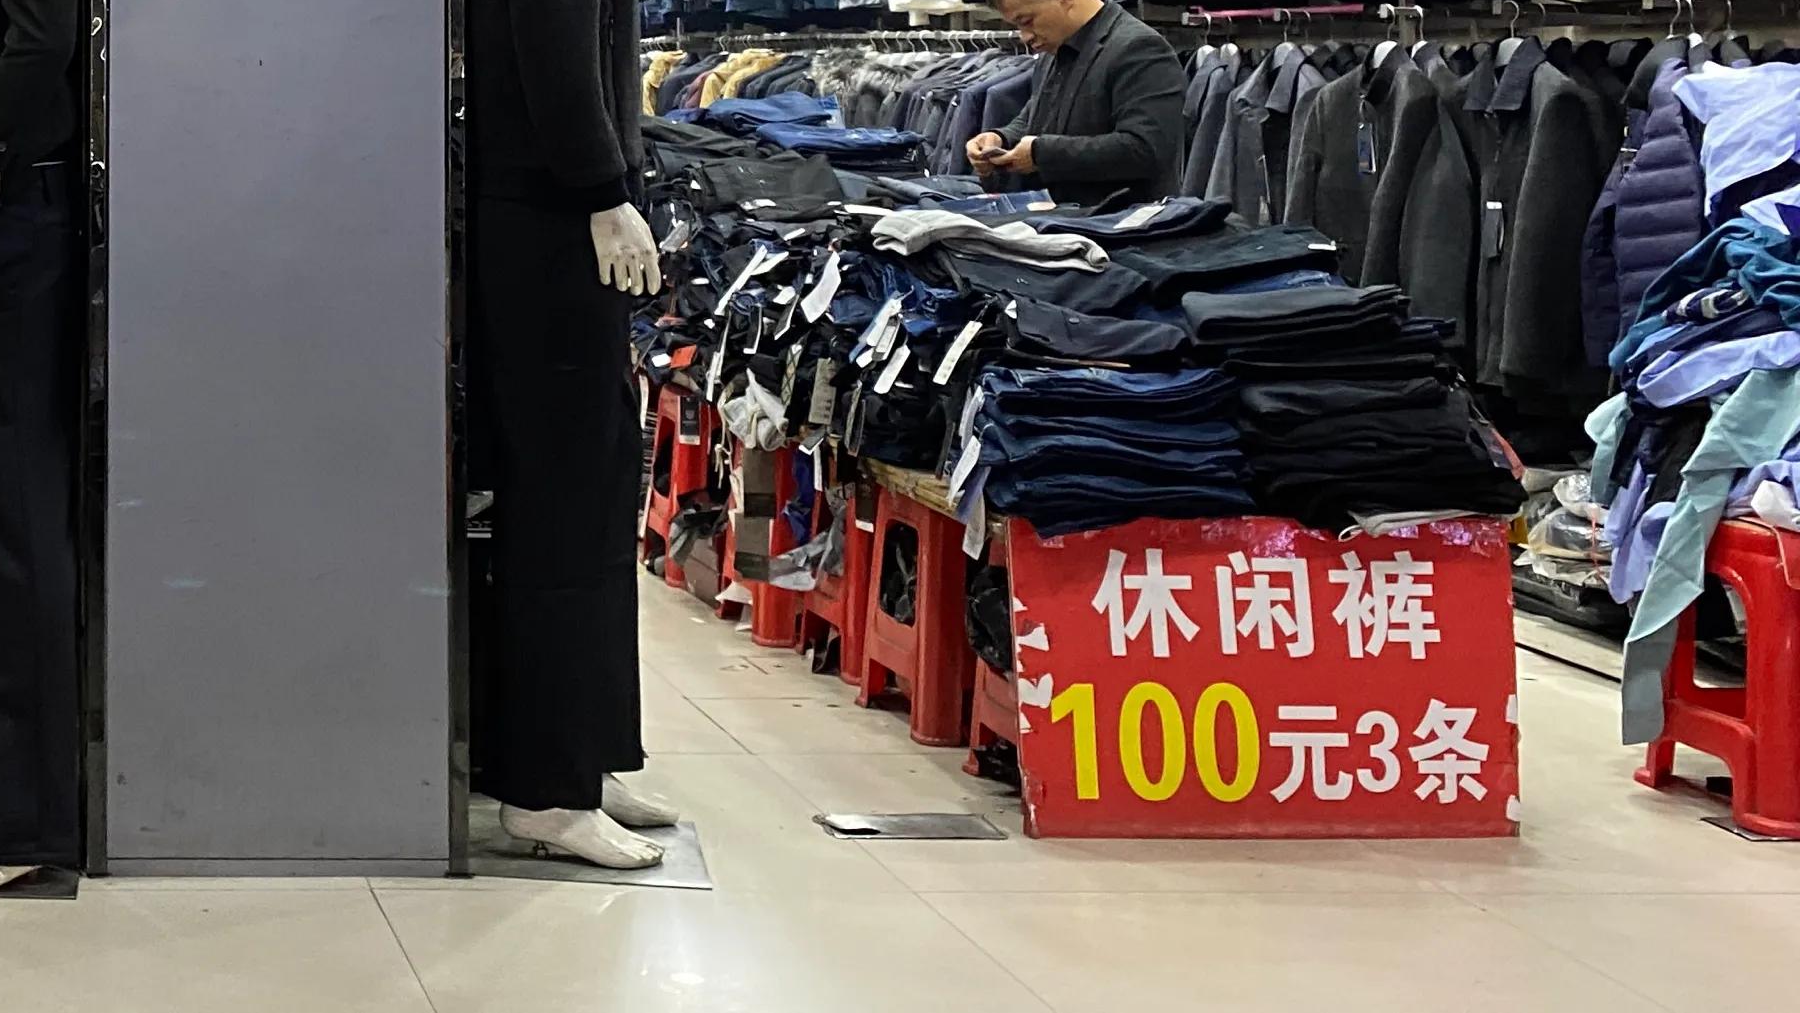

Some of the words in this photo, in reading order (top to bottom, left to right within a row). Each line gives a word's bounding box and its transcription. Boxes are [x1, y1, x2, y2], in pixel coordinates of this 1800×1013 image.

[1092, 548, 1441, 660] 休闲裤
[1051, 682, 1490, 804] 100元3条
